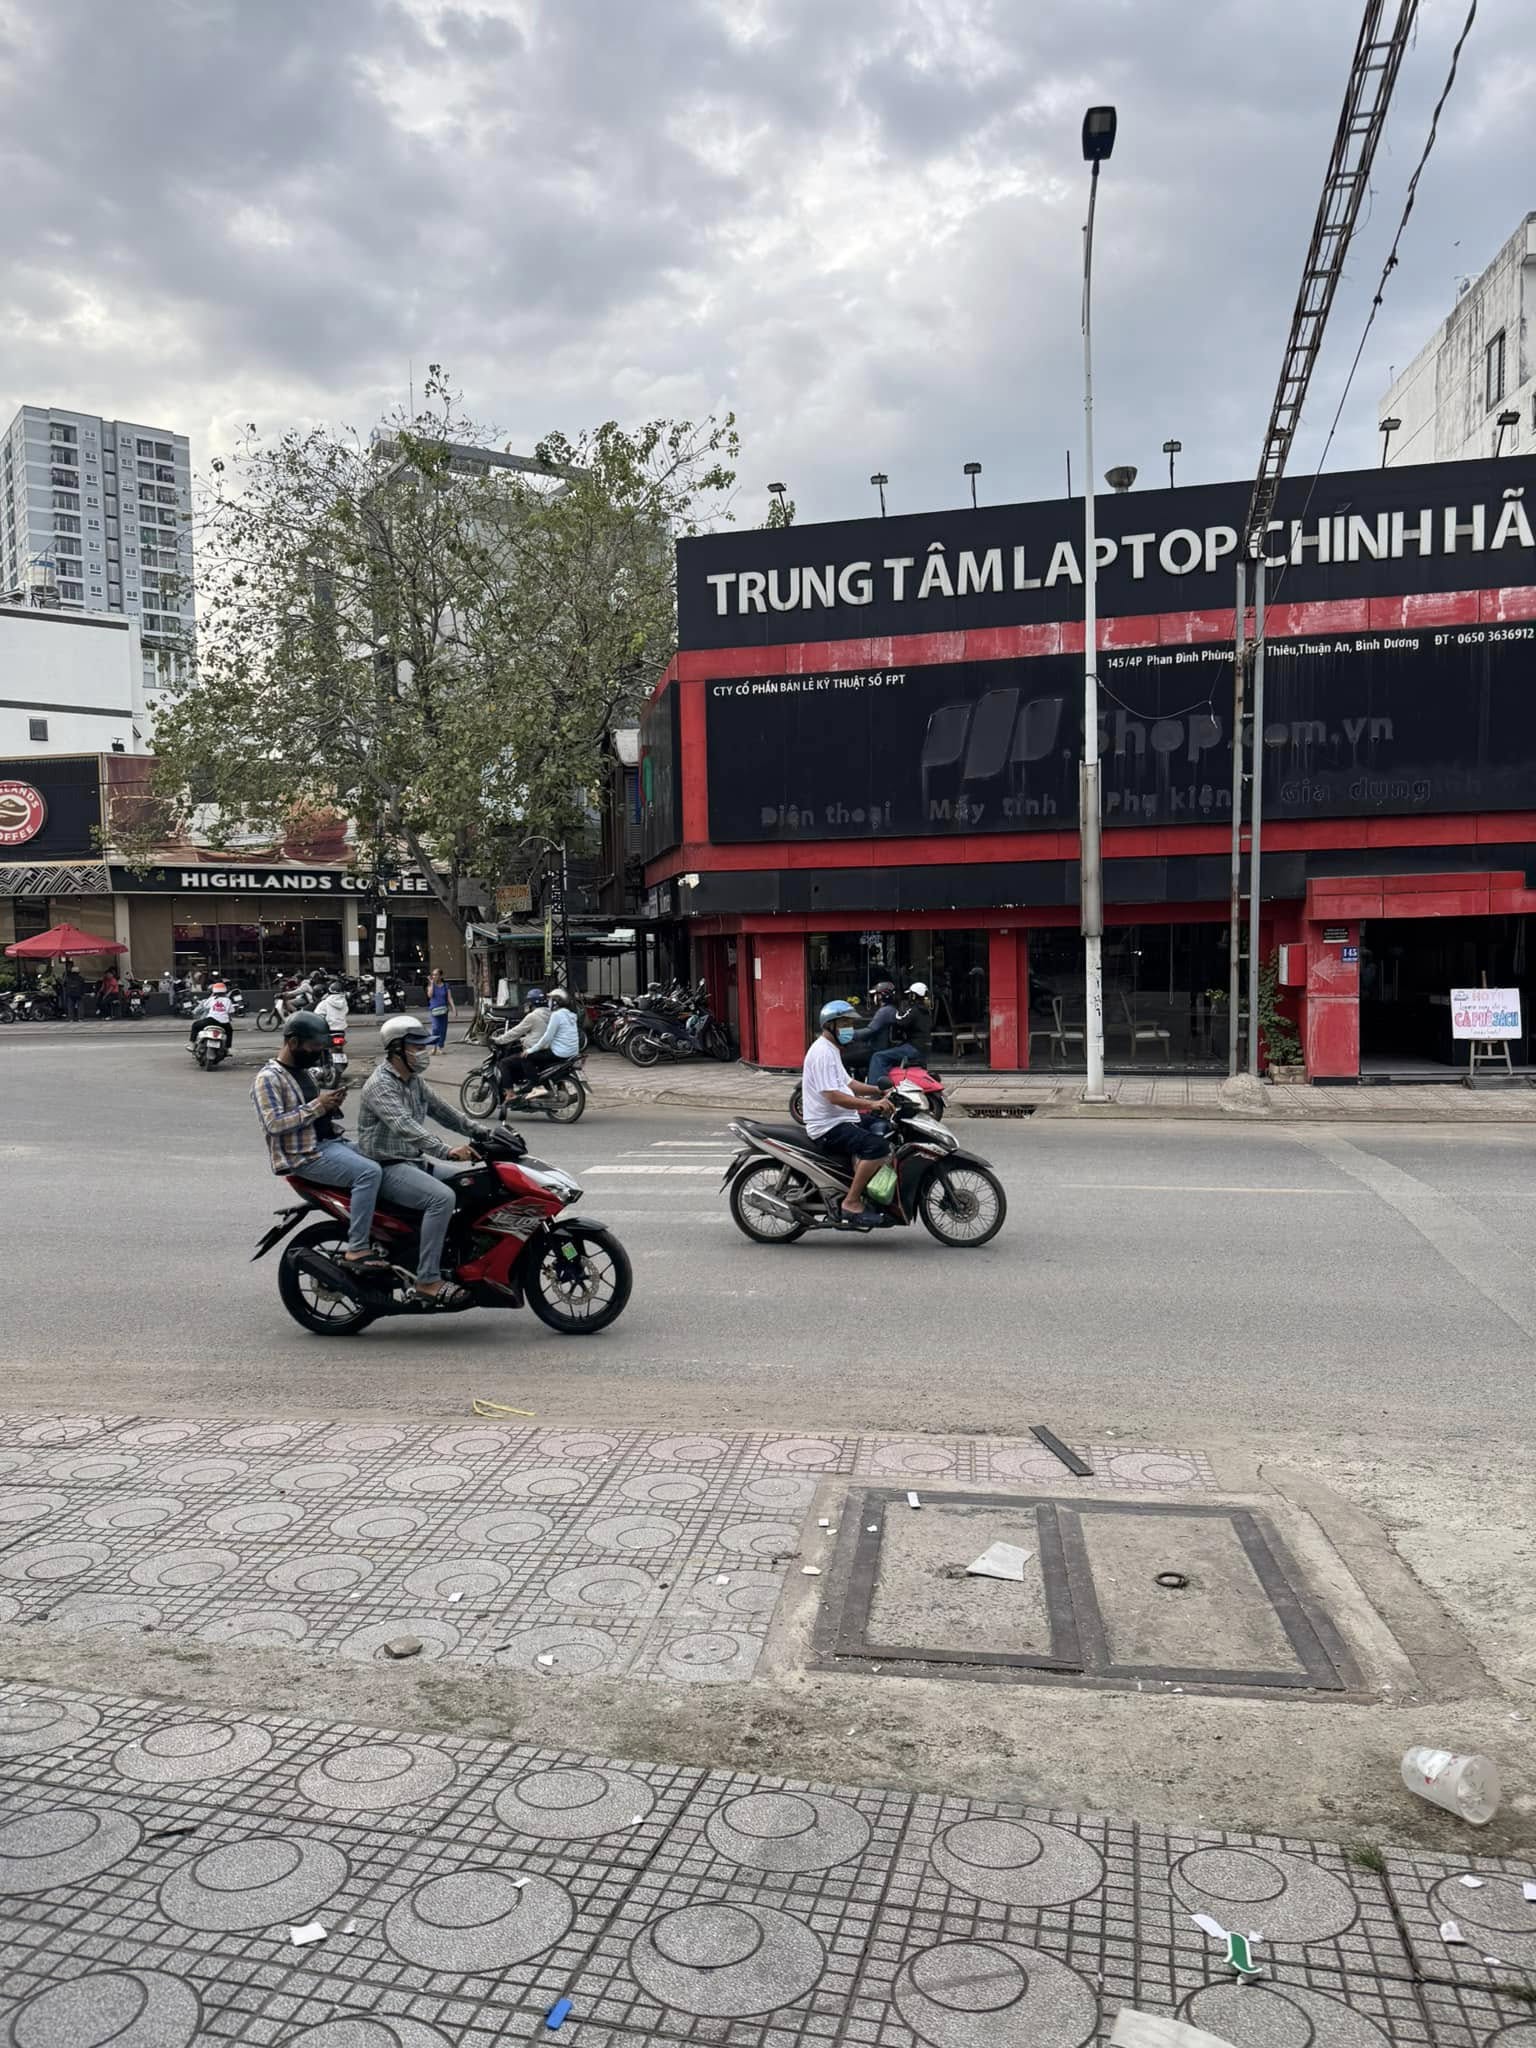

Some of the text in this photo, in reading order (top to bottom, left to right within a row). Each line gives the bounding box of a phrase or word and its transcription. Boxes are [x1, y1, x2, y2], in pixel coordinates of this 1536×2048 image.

[706, 560, 873, 616] TRUNG
[883, 541, 1004, 601] TÂM
[1013, 526, 1239, 590] LAPTOP
[1249, 503, 1433, 568] CHÍNH
[1457, 631, 1485, 644] 0650
[1487, 628, 1535, 642] 3636912
[1334, 642, 1352, 654] An,
[1383, 637, 1420, 650] Dương
[1107, 655, 1143, 669] 145/4P
[1146, 654, 1173, 666] Phan
[1175, 651, 1199, 664] Đình
[712, 685, 733, 697] CTY
[735, 680, 750, 696] CỔ
[802, 677, 814, 691] LẺ
[833, 675, 866, 691] THUẬT
[868, 671, 882, 686] SỐ
[886, 673, 906, 686] FPT
[180, 872, 332, 890] HIGHLANDS
